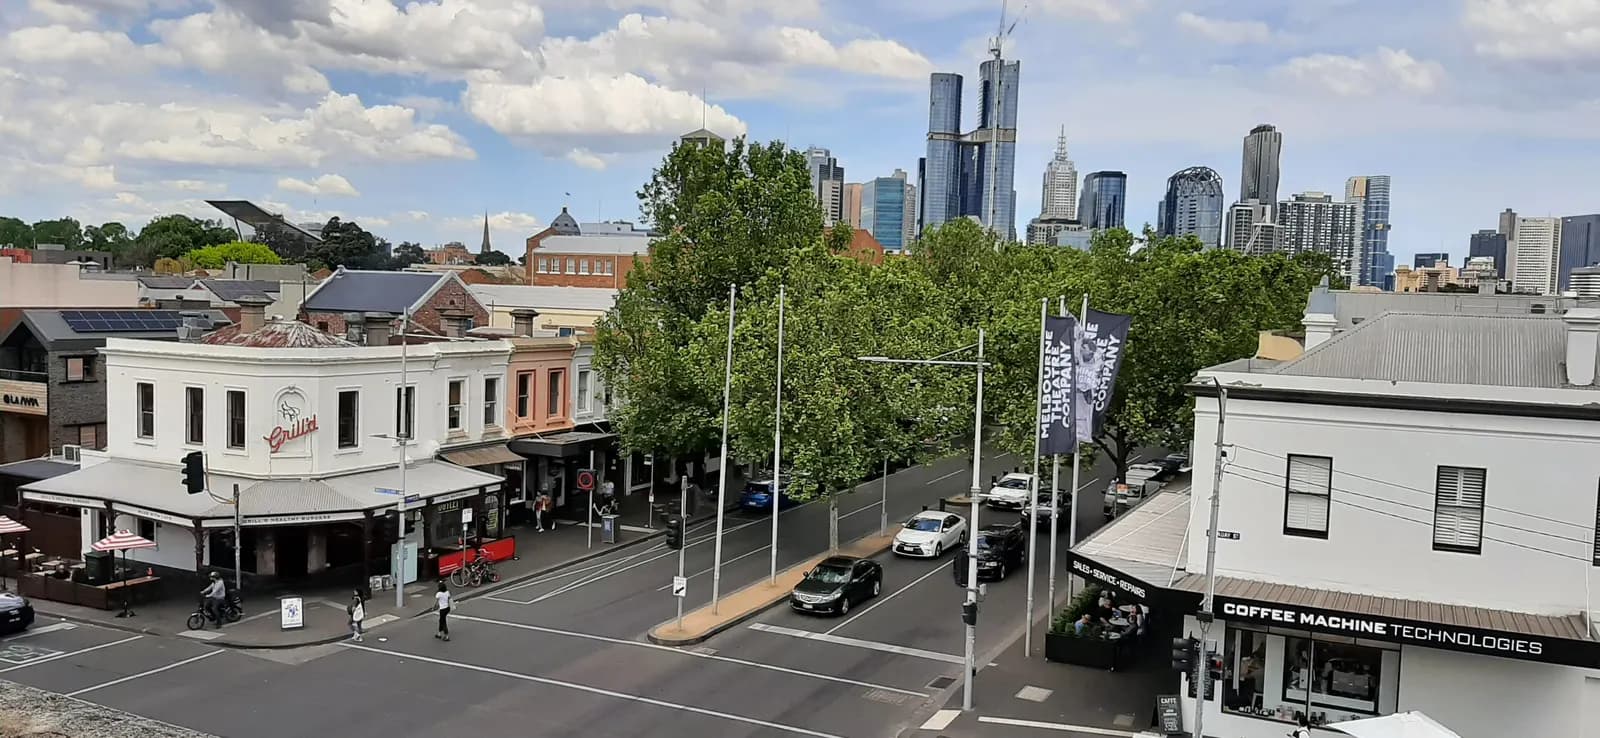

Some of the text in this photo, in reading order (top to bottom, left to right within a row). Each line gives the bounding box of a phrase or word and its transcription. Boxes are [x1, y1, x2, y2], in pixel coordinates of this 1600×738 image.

[1041, 330, 1054, 439] MELBOURNE
[1051, 346, 1062, 423] THEATRE
[1060, 341, 1072, 428] COMPANY
[1095, 334, 1121, 411] COMPANY
[262, 414, 319, 453] Grill'd
[1073, 560, 1146, 598] SALES SERVICE REPAIRS
[1223, 602, 1543, 655] COFFEE MACHINE TECHNOLOGIES
